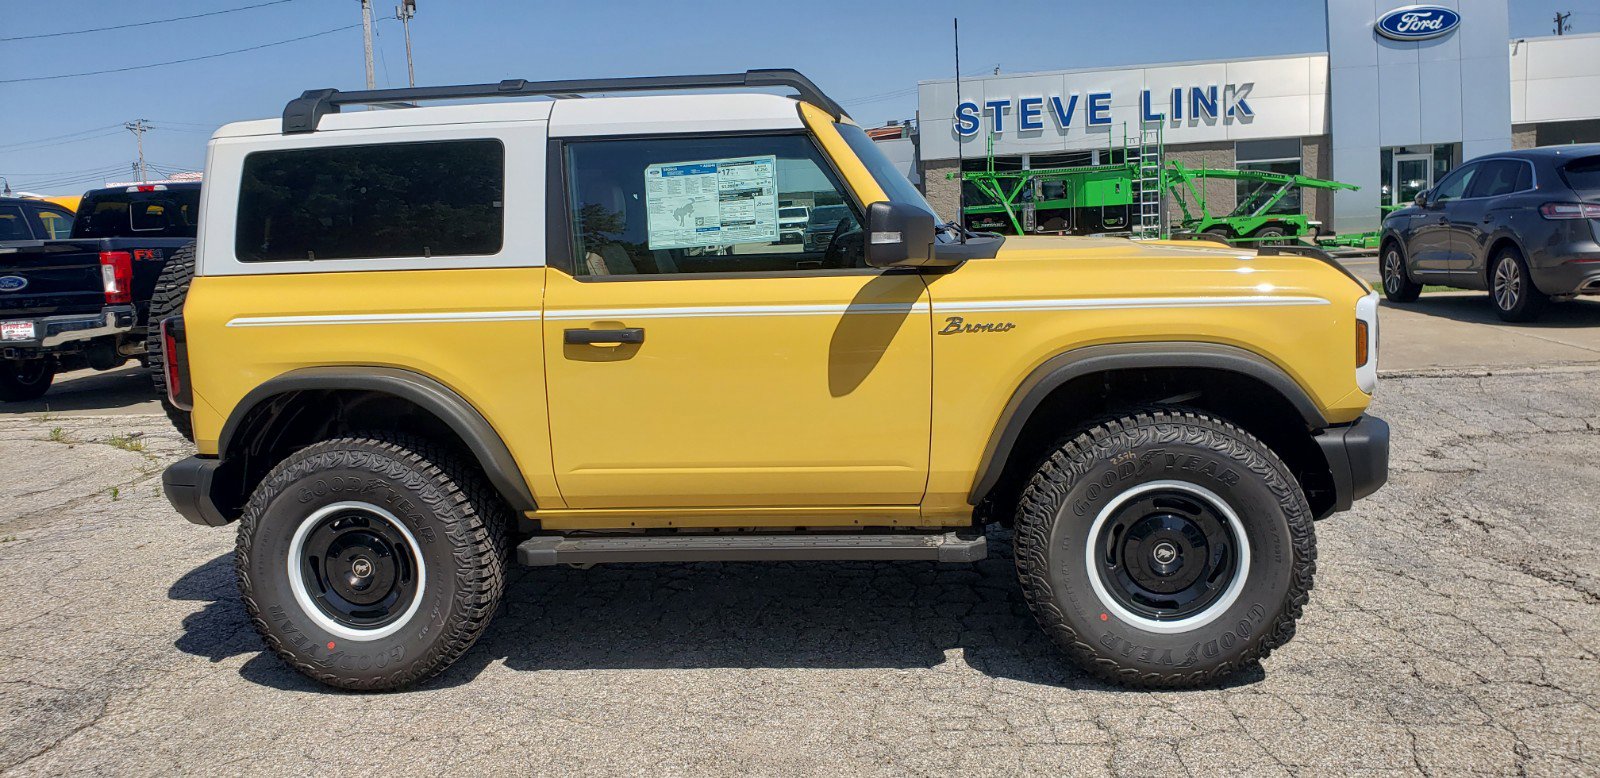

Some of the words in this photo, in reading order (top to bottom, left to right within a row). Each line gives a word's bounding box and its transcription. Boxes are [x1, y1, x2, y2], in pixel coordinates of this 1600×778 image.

[1397, 12, 1444, 32] Ford
[954, 92, 1113, 136] STEVE
[1141, 82, 1254, 123] LINK
[938, 316, 1016, 335] Bronco
